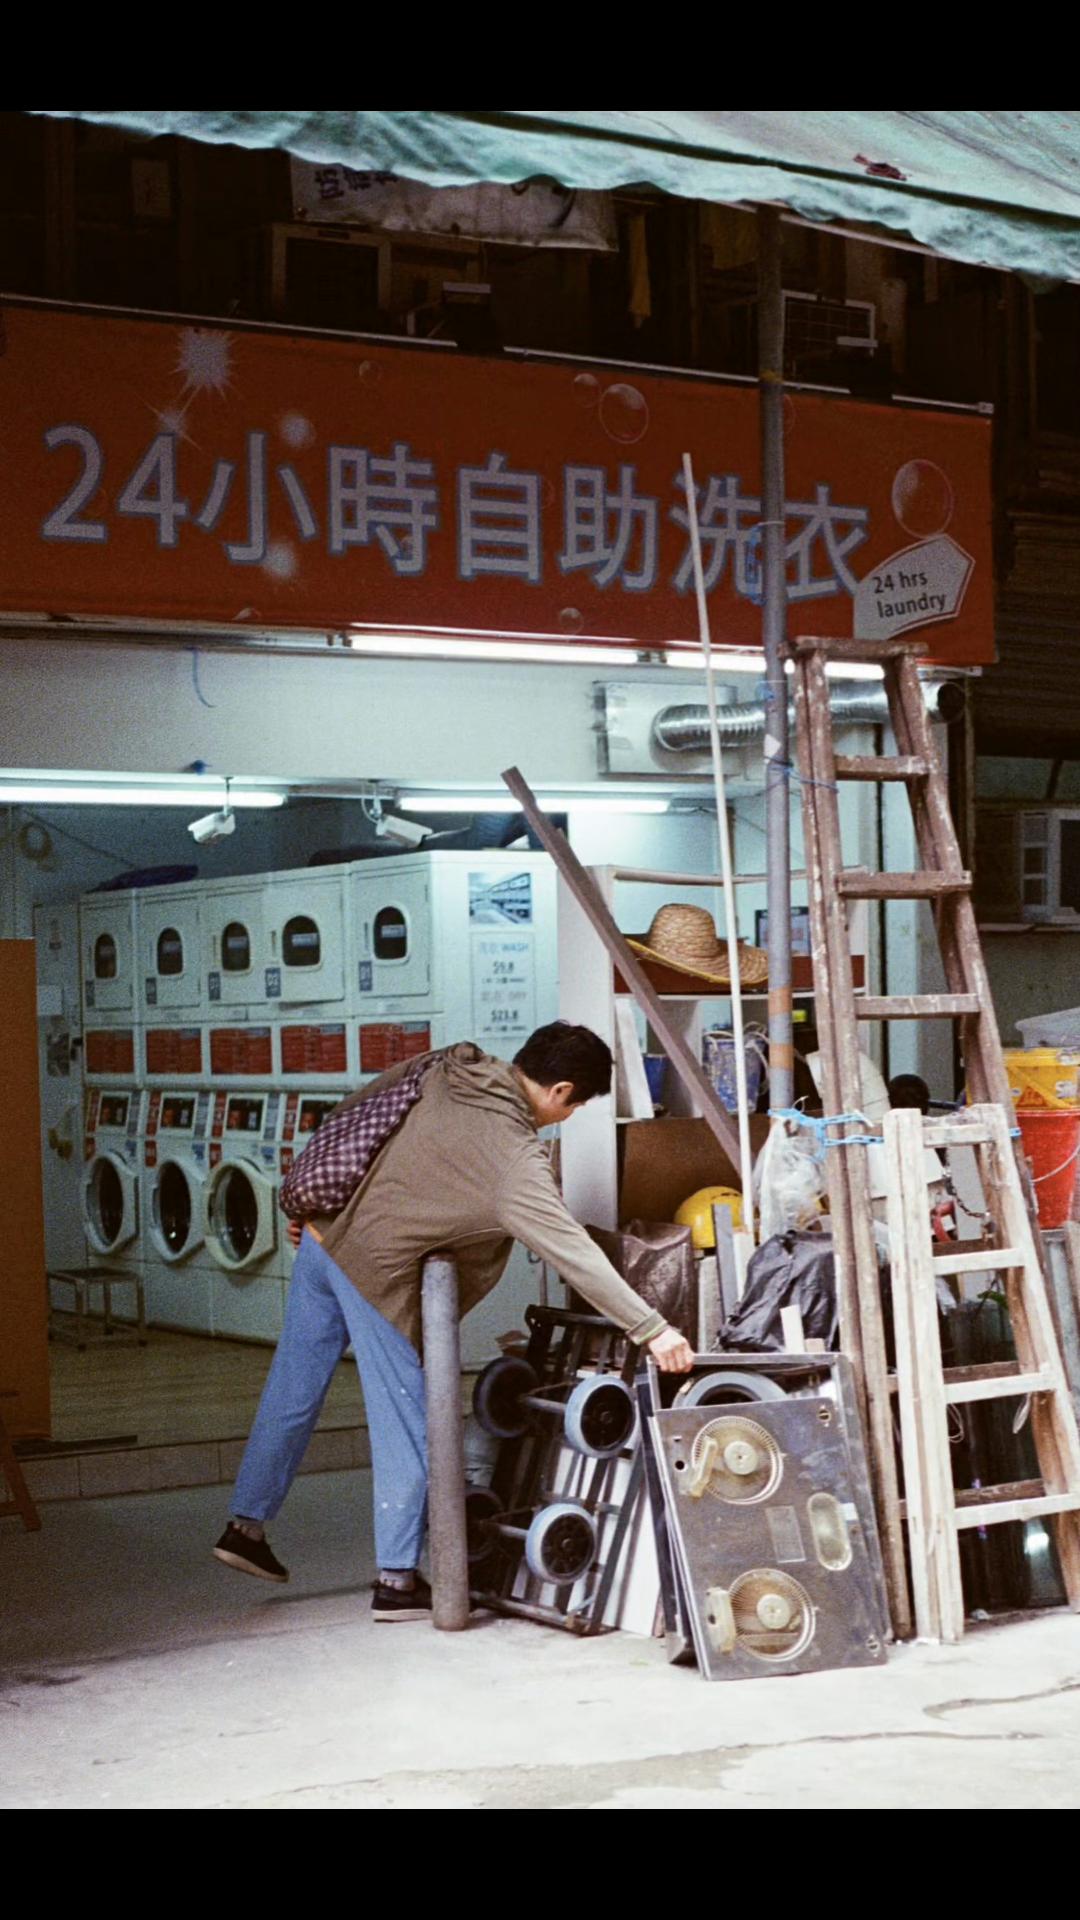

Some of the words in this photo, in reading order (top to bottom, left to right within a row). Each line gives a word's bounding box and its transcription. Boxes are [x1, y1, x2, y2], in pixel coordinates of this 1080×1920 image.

[42, 424, 868, 602] 24小時自助洗衣
[873, 574, 894, 594] 24
[898, 571, 928, 589] hrs
[877, 593, 947, 618] laundry
[502, 942, 529, 952] WASH
